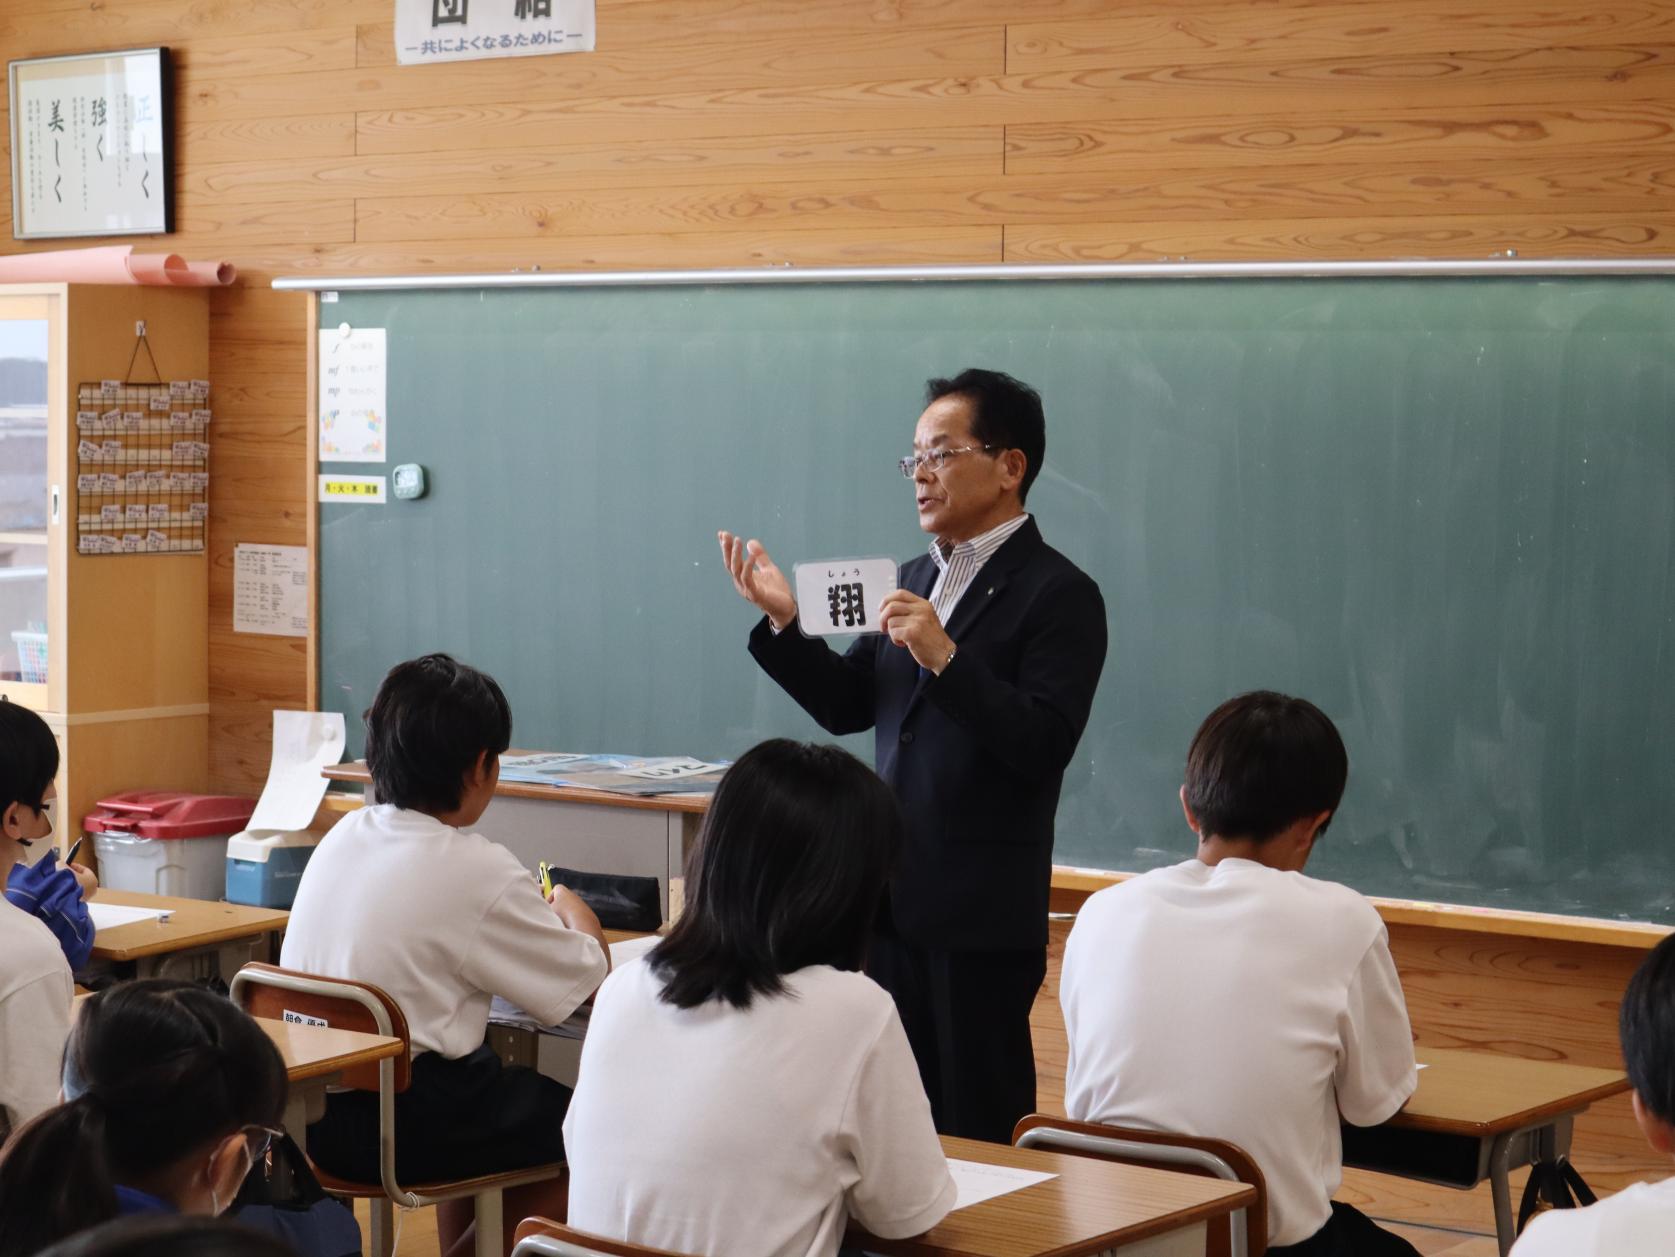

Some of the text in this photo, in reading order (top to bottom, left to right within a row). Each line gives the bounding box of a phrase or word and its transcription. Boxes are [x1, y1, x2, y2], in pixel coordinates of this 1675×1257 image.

[47, 98, 65, 203] 美しく
[91, 96, 107, 162] 強く
[137, 95, 154, 199] 正しく
[827, 582, 867, 627] 翔
[828, 568, 860, 578] しょう
